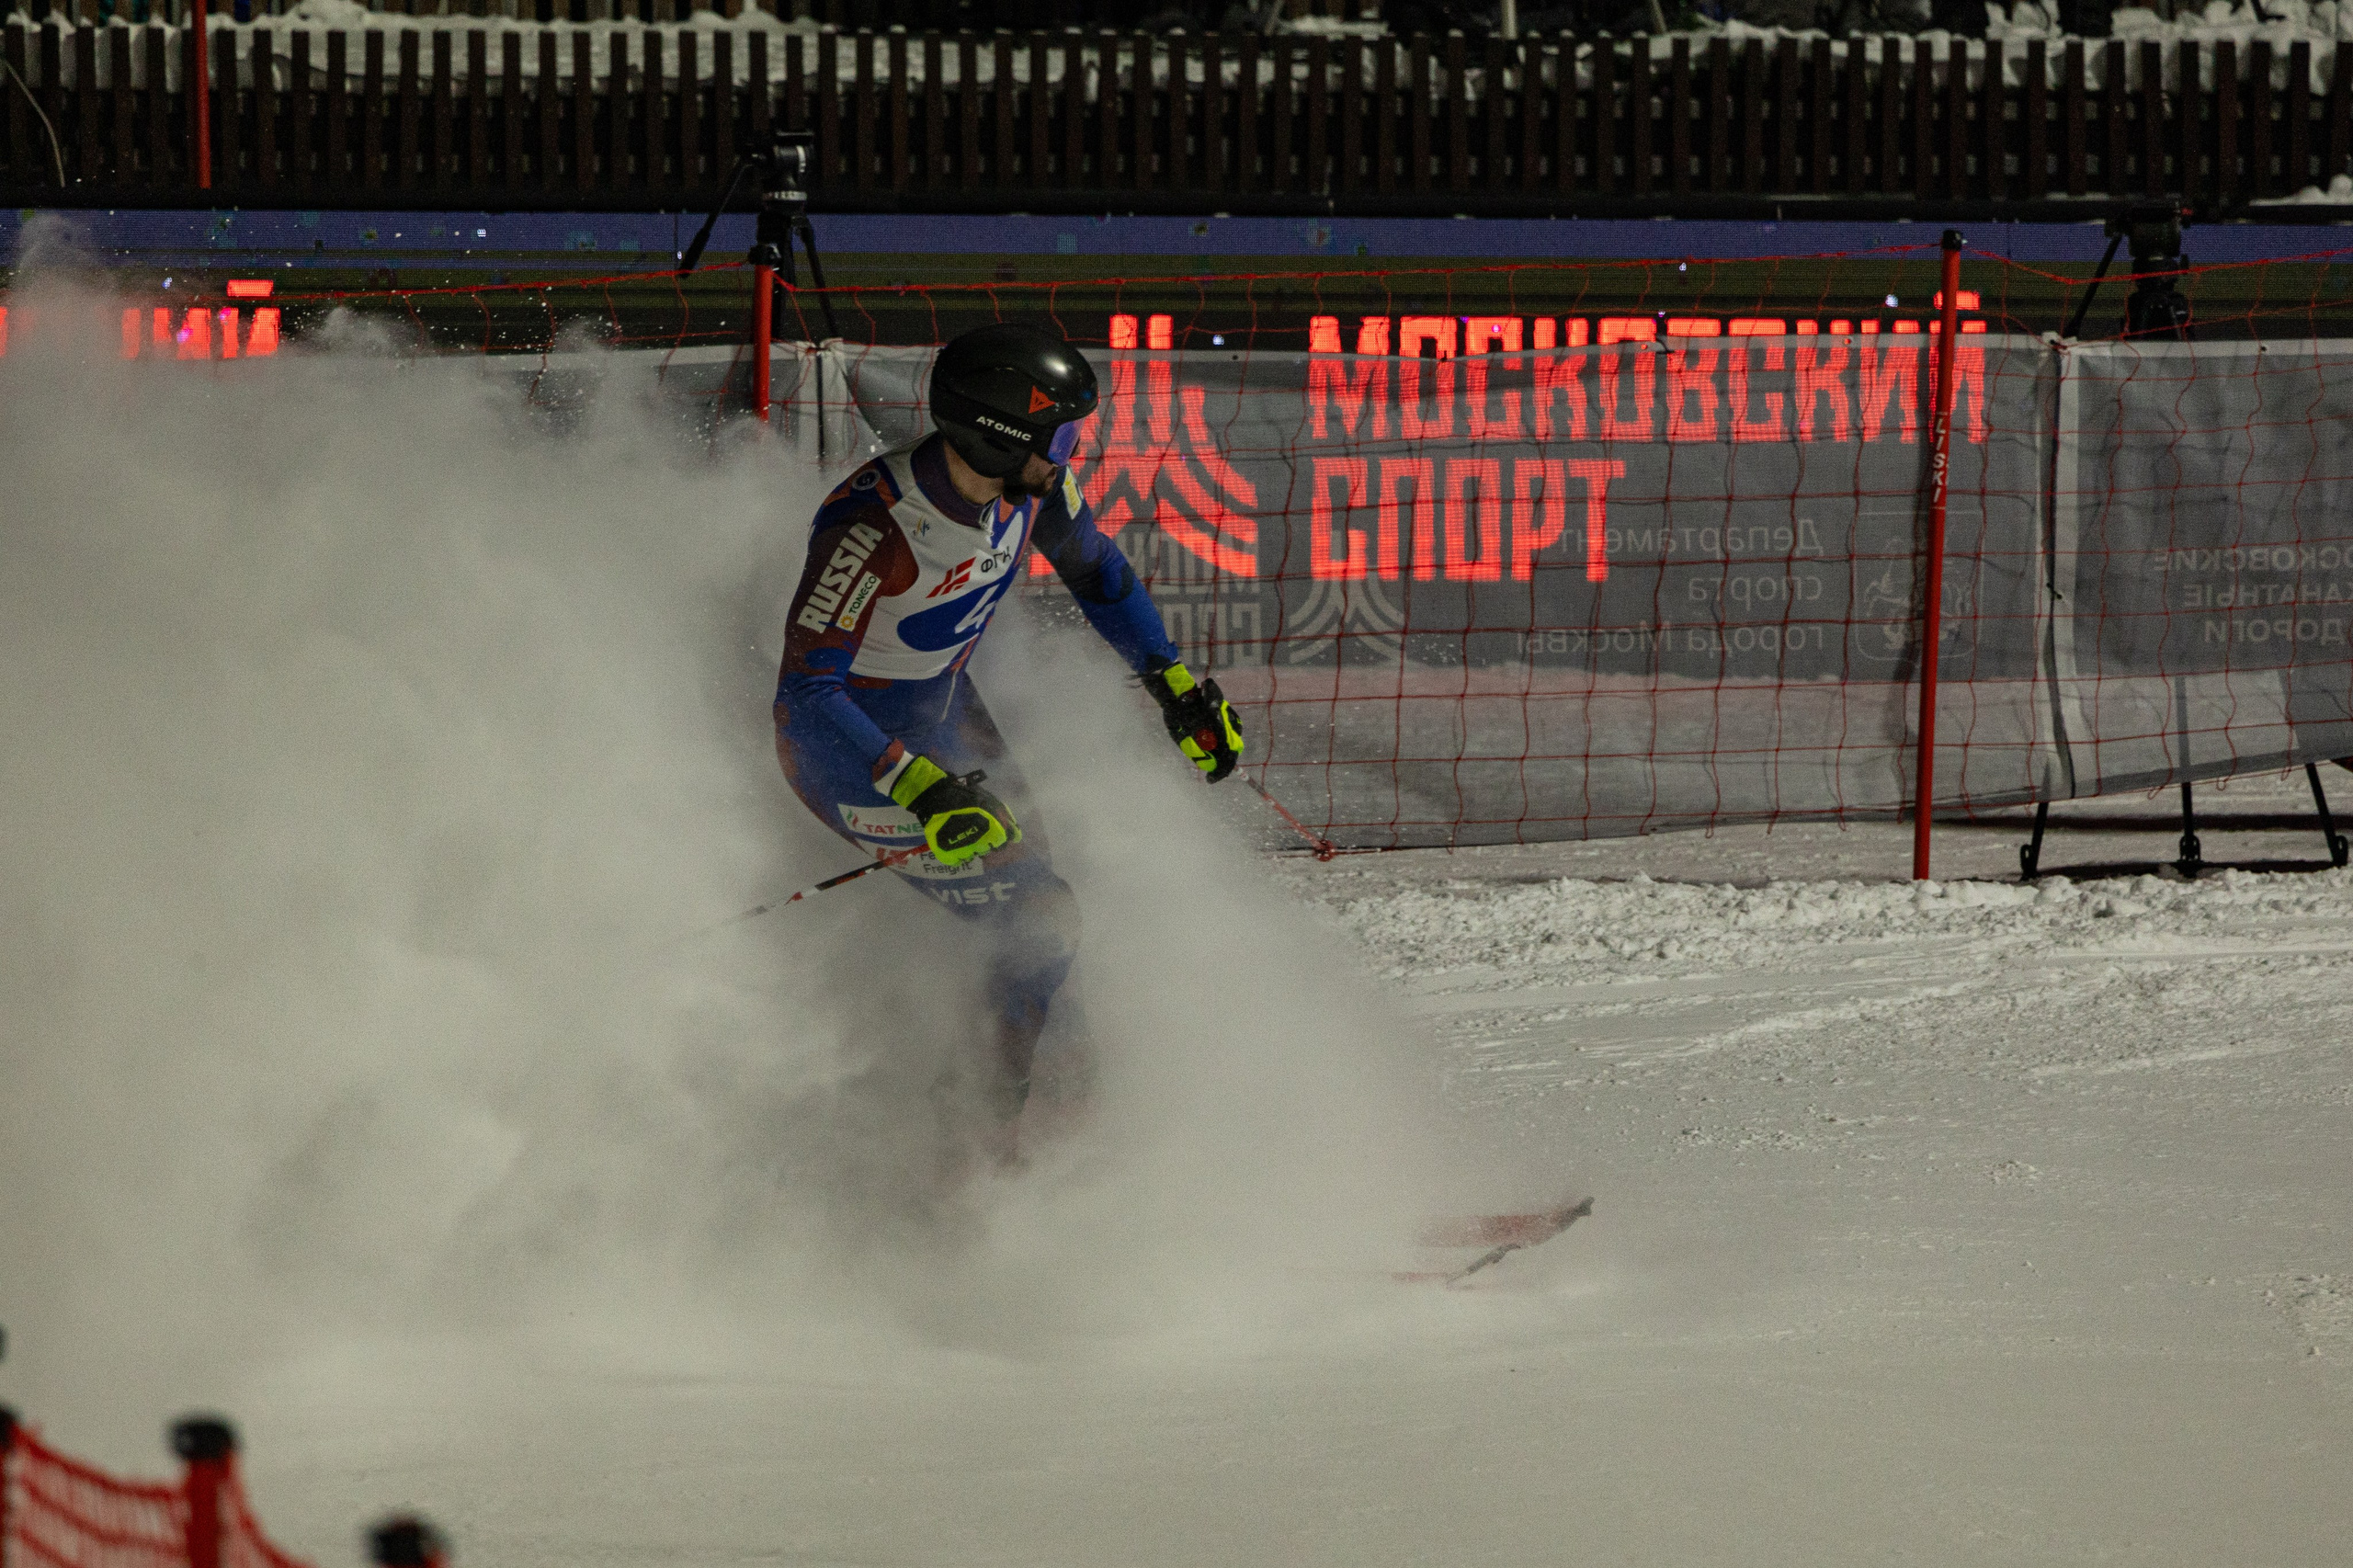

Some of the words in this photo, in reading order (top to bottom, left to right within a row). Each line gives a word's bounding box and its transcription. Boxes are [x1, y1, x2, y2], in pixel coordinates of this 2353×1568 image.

[1308, 290, 1986, 444] МОСКОВСКИЙ
[976, 415, 1032, 441] ATOMIC
[1932, 418, 1946, 504] LISKI
[1310, 458, 1625, 583] СПОРТ
[796, 522, 884, 634] RUSSIA
[863, 824, 924, 835] TATNE
[948, 826, 979, 845] LEKI
